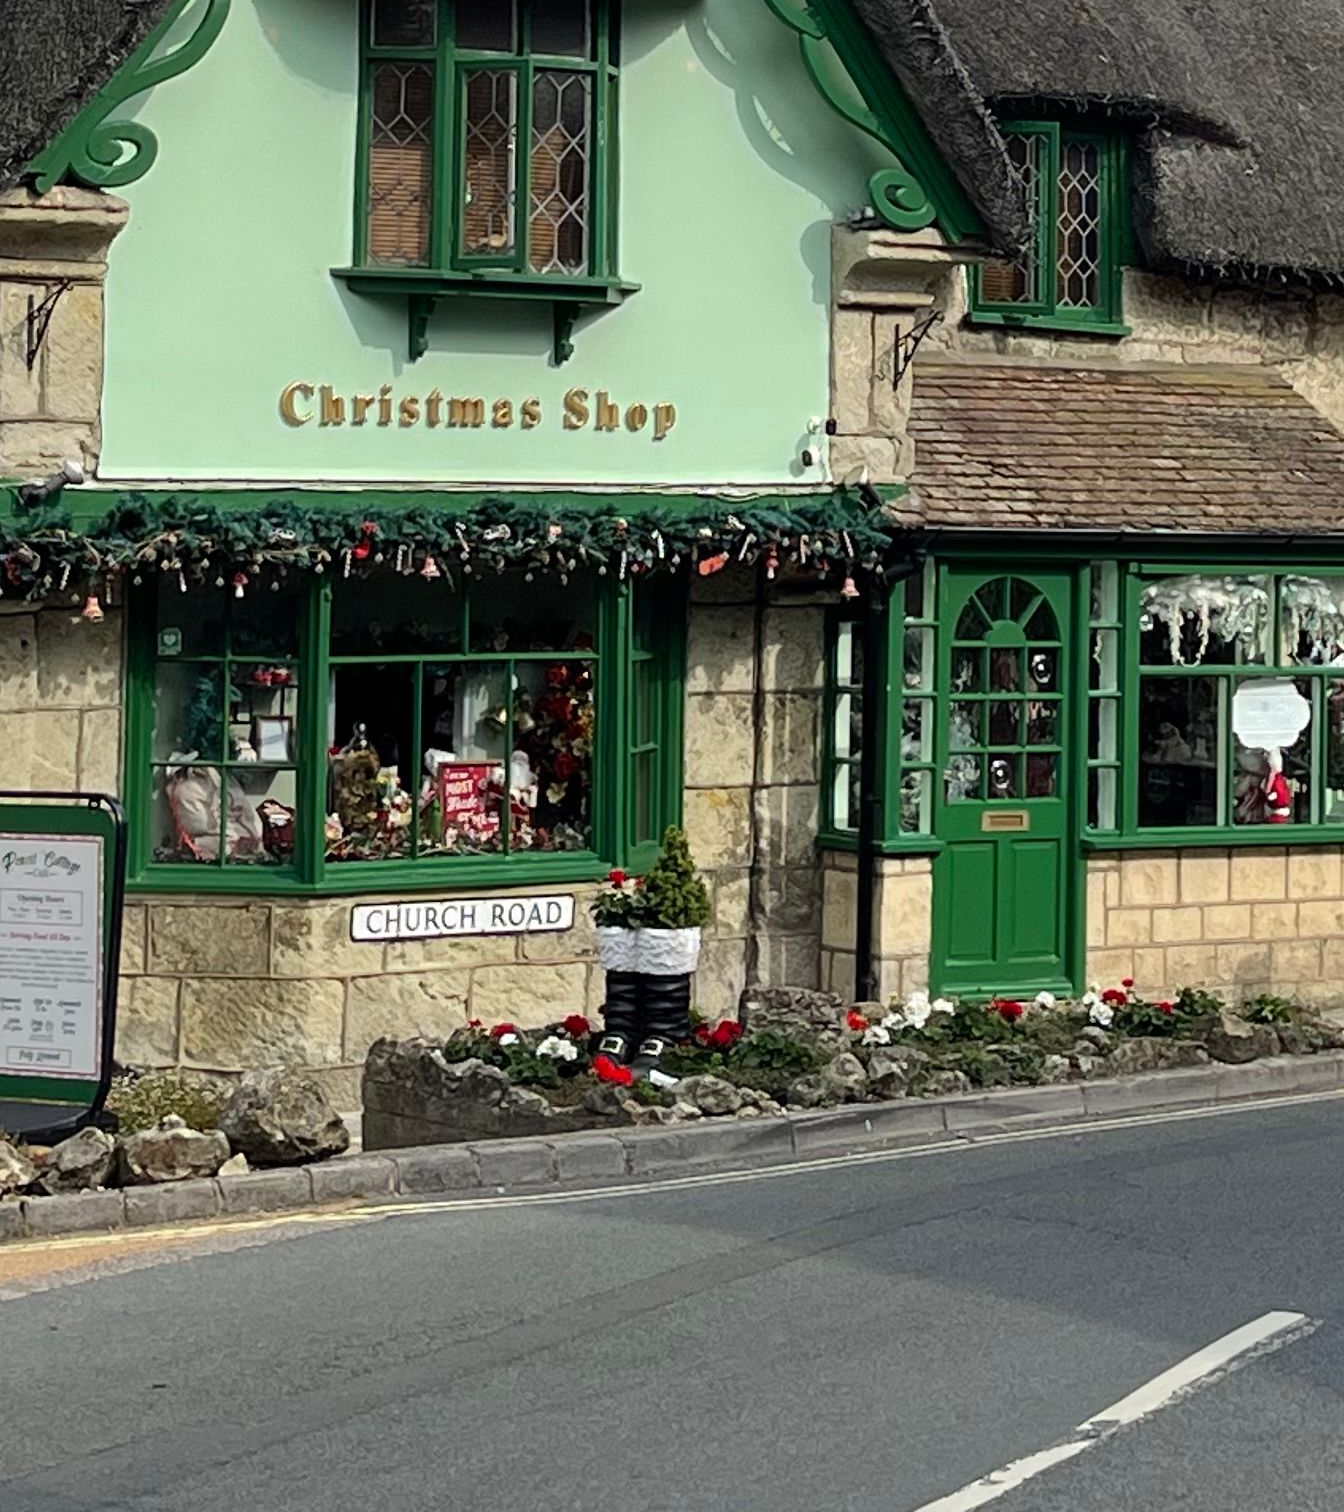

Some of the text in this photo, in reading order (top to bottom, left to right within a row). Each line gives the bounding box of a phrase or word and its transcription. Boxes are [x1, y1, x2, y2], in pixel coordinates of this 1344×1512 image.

[279, 381, 676, 441] Christmas Shop
[366, 901, 563, 934] CHURCH ROAD
